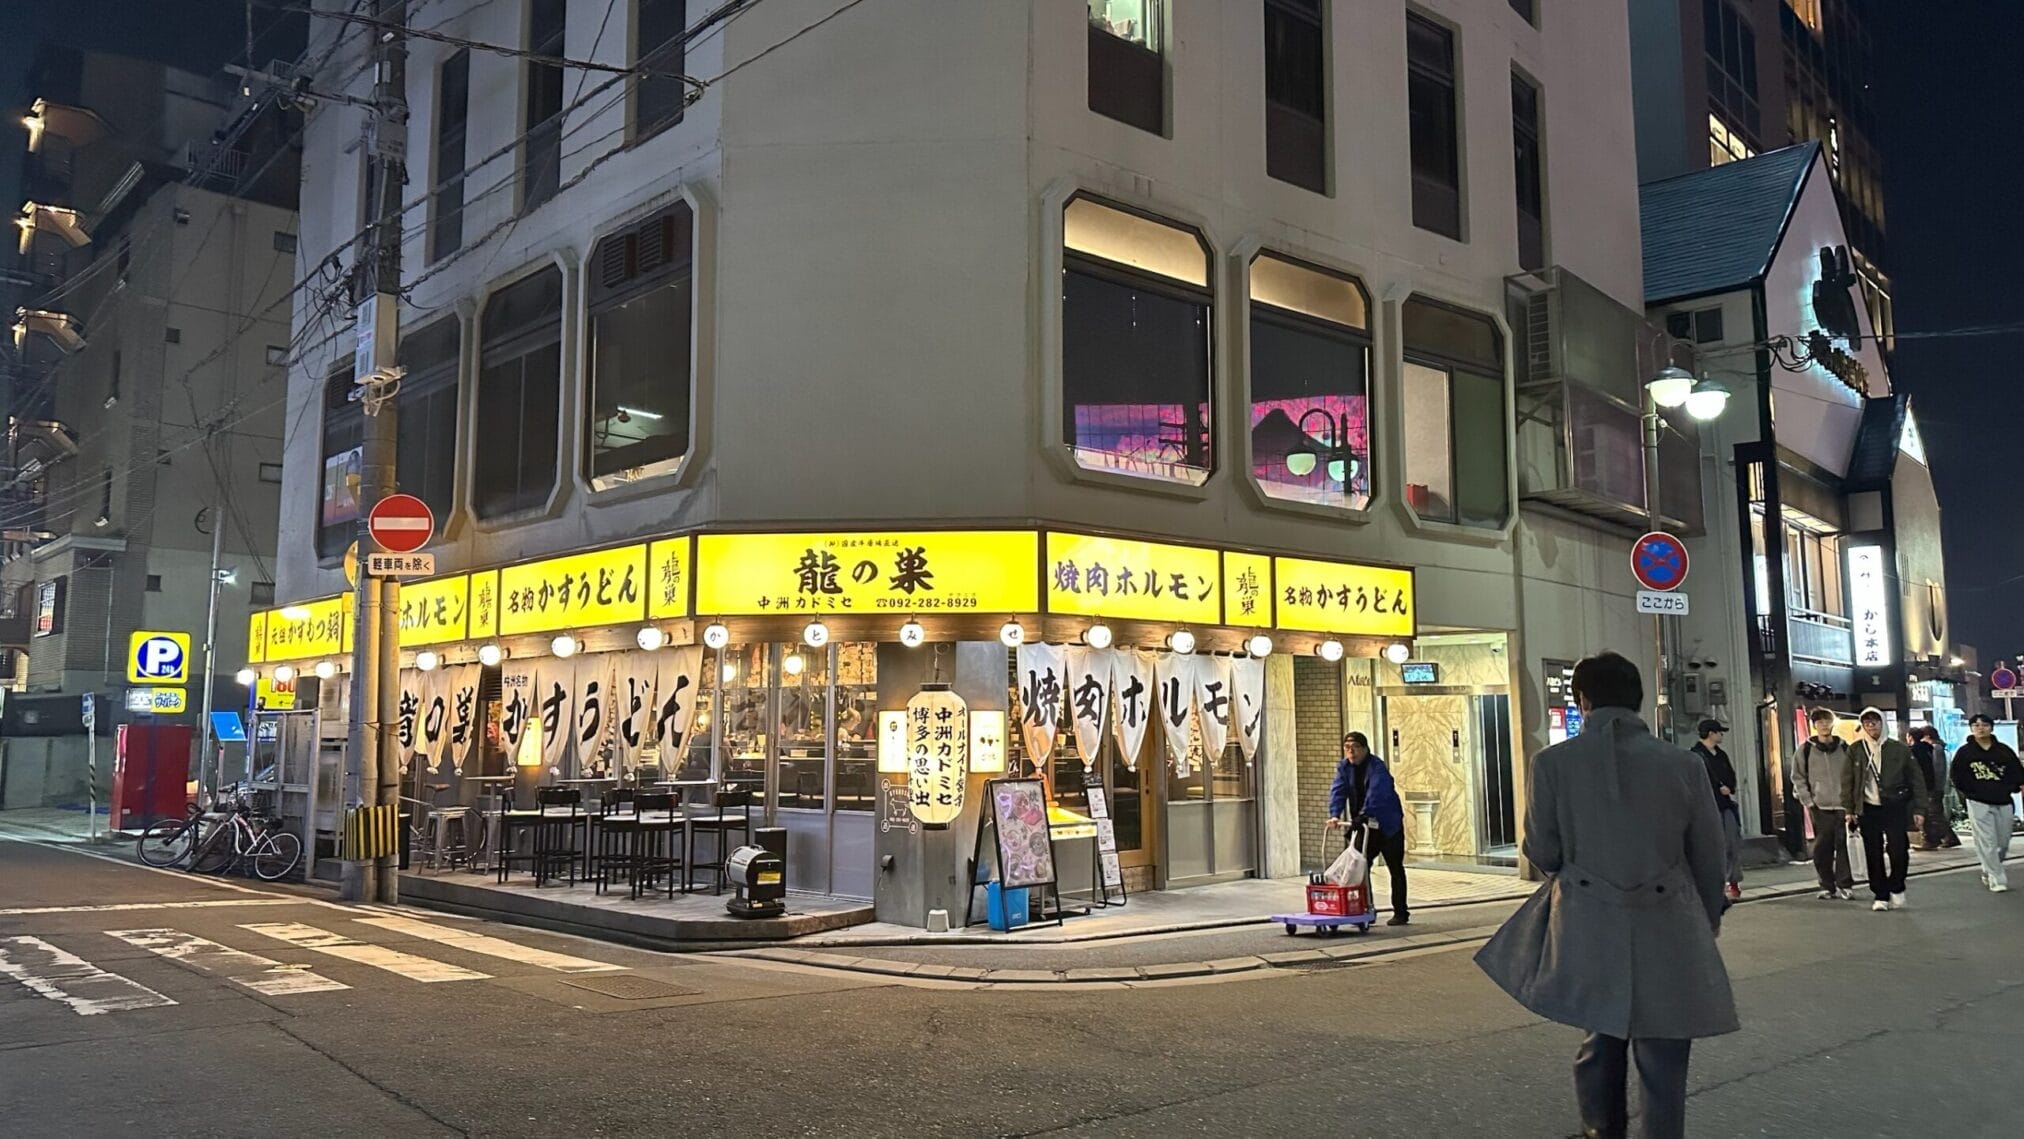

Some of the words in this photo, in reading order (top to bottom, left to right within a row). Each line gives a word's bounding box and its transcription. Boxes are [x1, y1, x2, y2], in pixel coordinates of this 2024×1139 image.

[373, 558, 430, 571] 軽車両を除く
[661, 550, 681, 607] 龍の巣
[793, 546, 934, 594] 龍の巣
[1053, 559, 1213, 602] 焼肉ホルモン
[507, 563, 638, 614] 名物かすうどん
[758, 595, 852, 609] 中洲カドミセ
[889, 598, 977, 608] 092-282-8929
[1236, 566, 1259, 616] 龍の巣
[1284, 584, 1408, 615] 名物かすうどん
[1642, 596, 1684, 610] ここから
[146, 640, 180, 674] P
[710, 631, 721, 642] か
[906, 630, 918, 641] み
[1007, 630, 1019, 640] せ
[503, 675, 690, 749] かすうどん
[1023, 667, 1261, 737] 焼肉ホルモン
[913, 706, 931, 807] 博多の思い出
[935, 706, 953, 807] 中洲カドミセ
